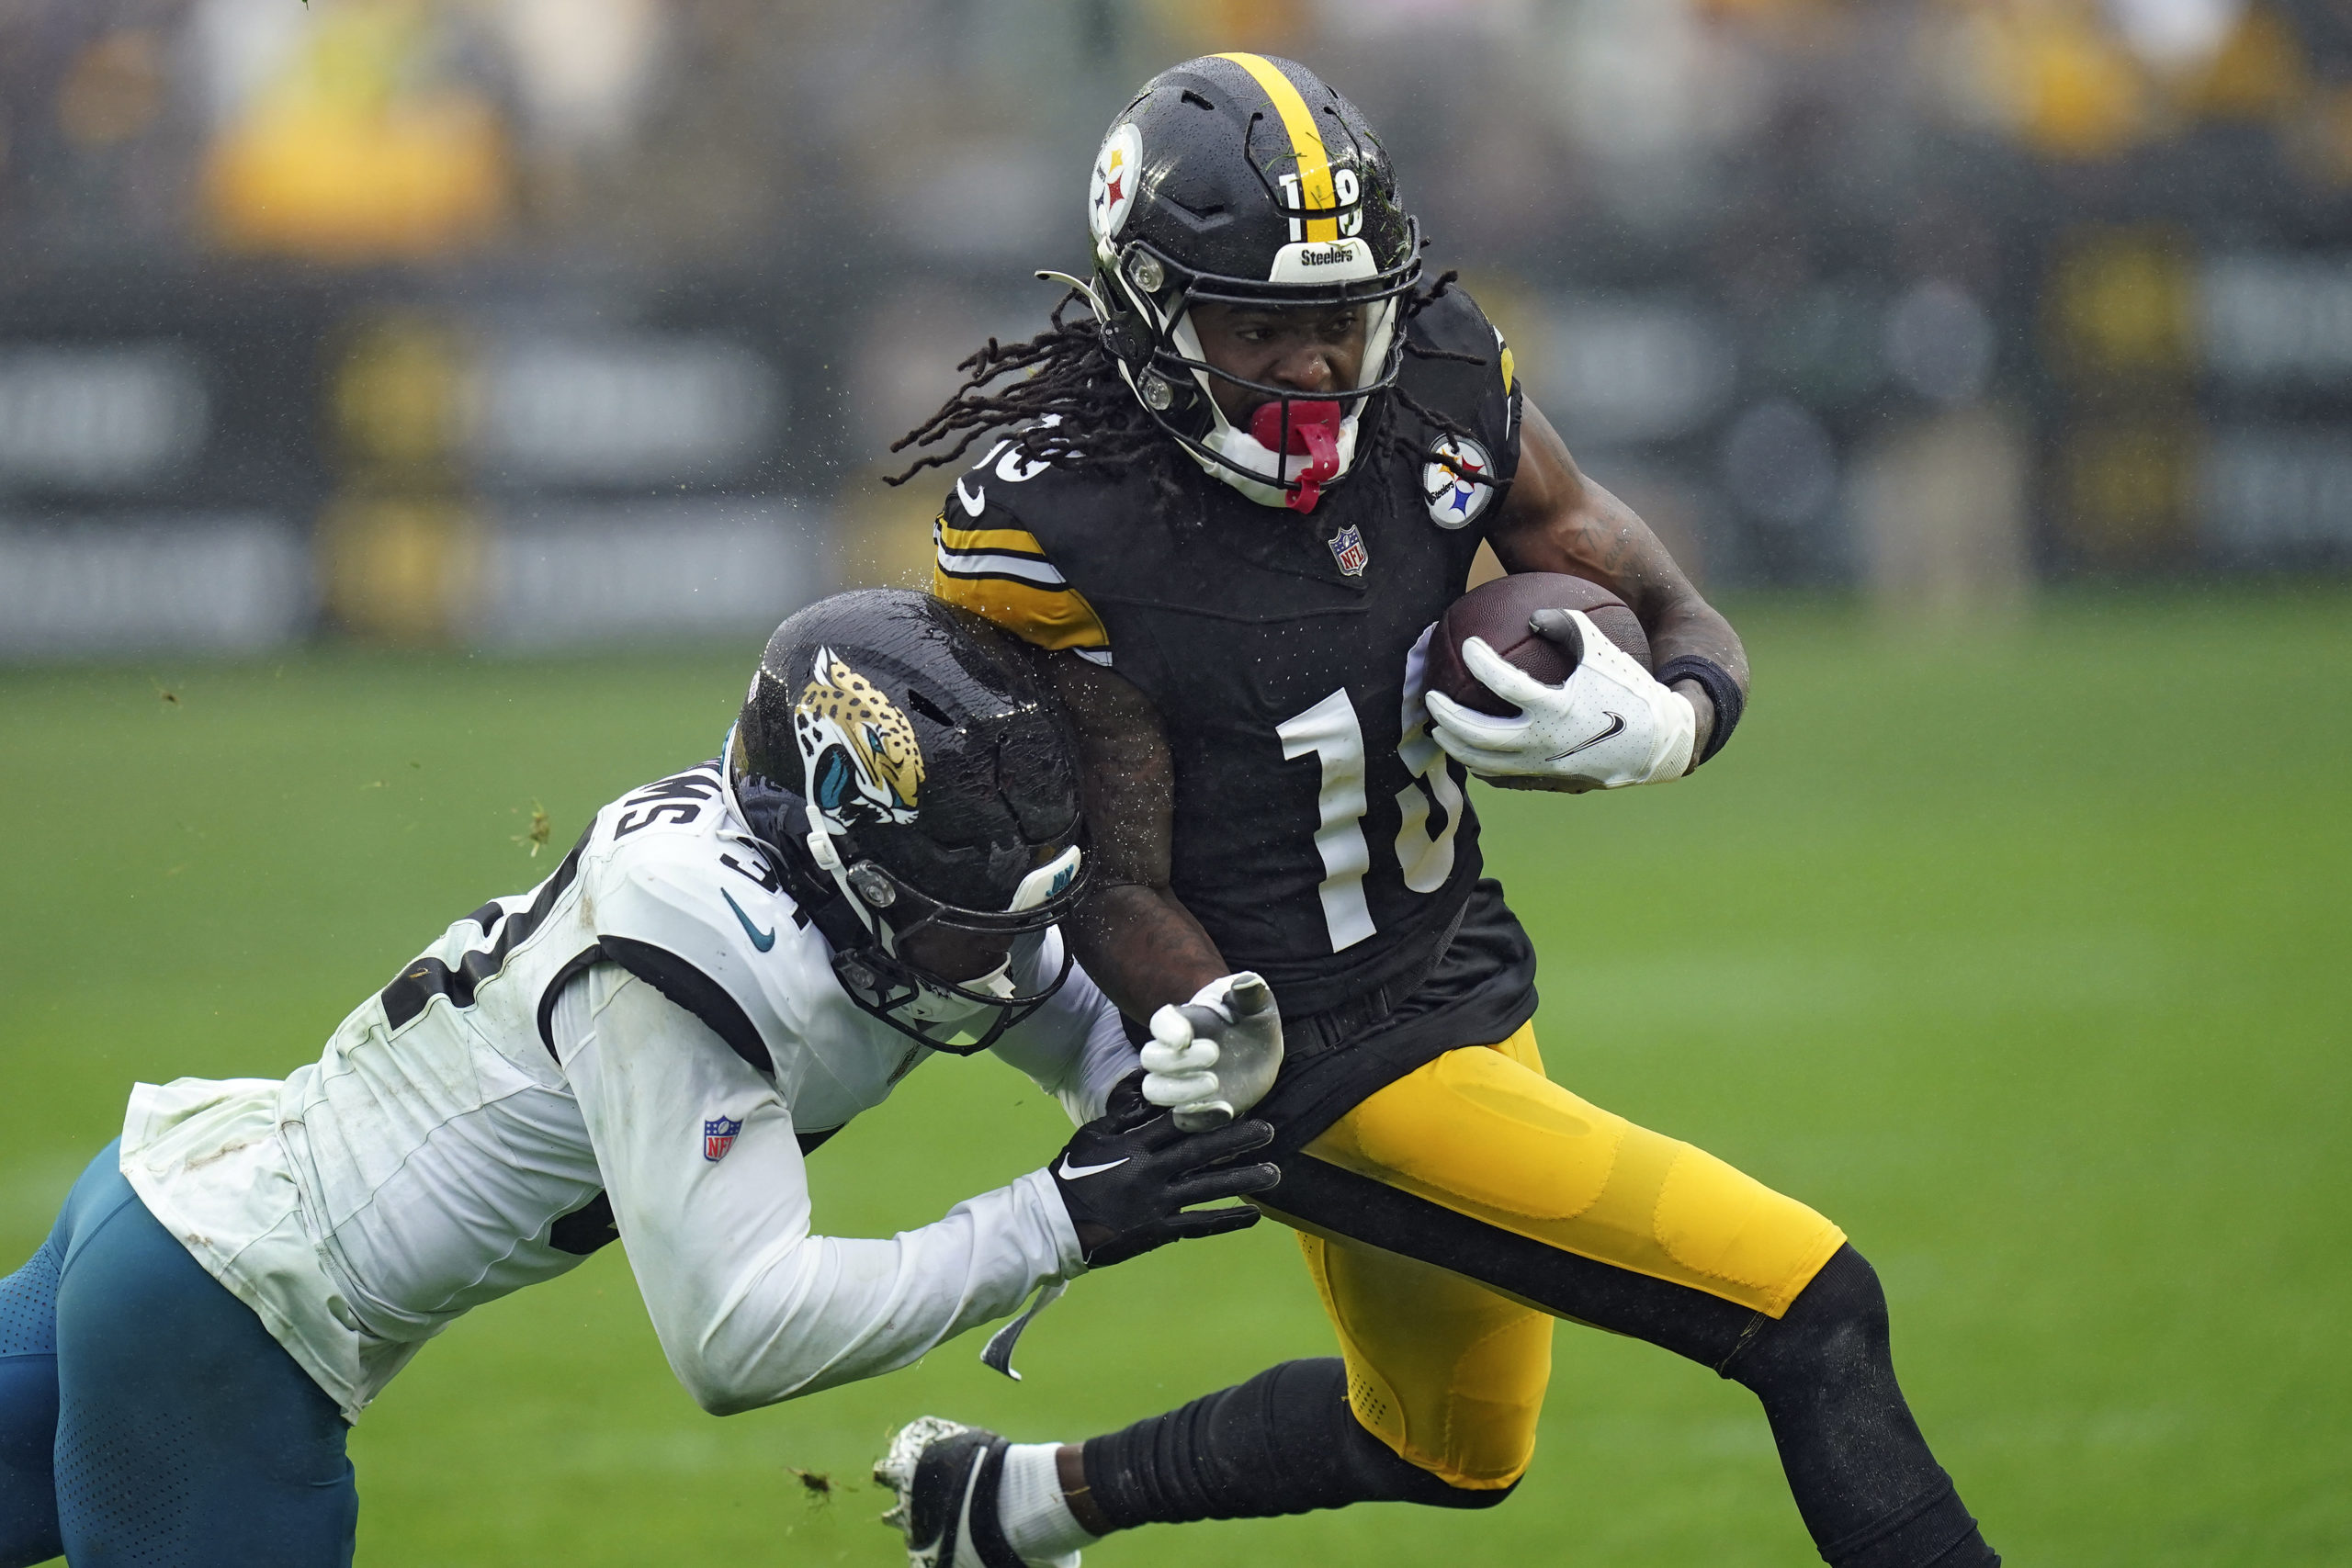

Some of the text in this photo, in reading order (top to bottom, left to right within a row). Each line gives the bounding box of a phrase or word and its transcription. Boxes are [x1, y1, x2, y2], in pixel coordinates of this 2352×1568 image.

[1279, 169, 1363, 243] 19
[1301, 247, 1353, 266] Steelers
[1340, 546, 1365, 570] NFL
